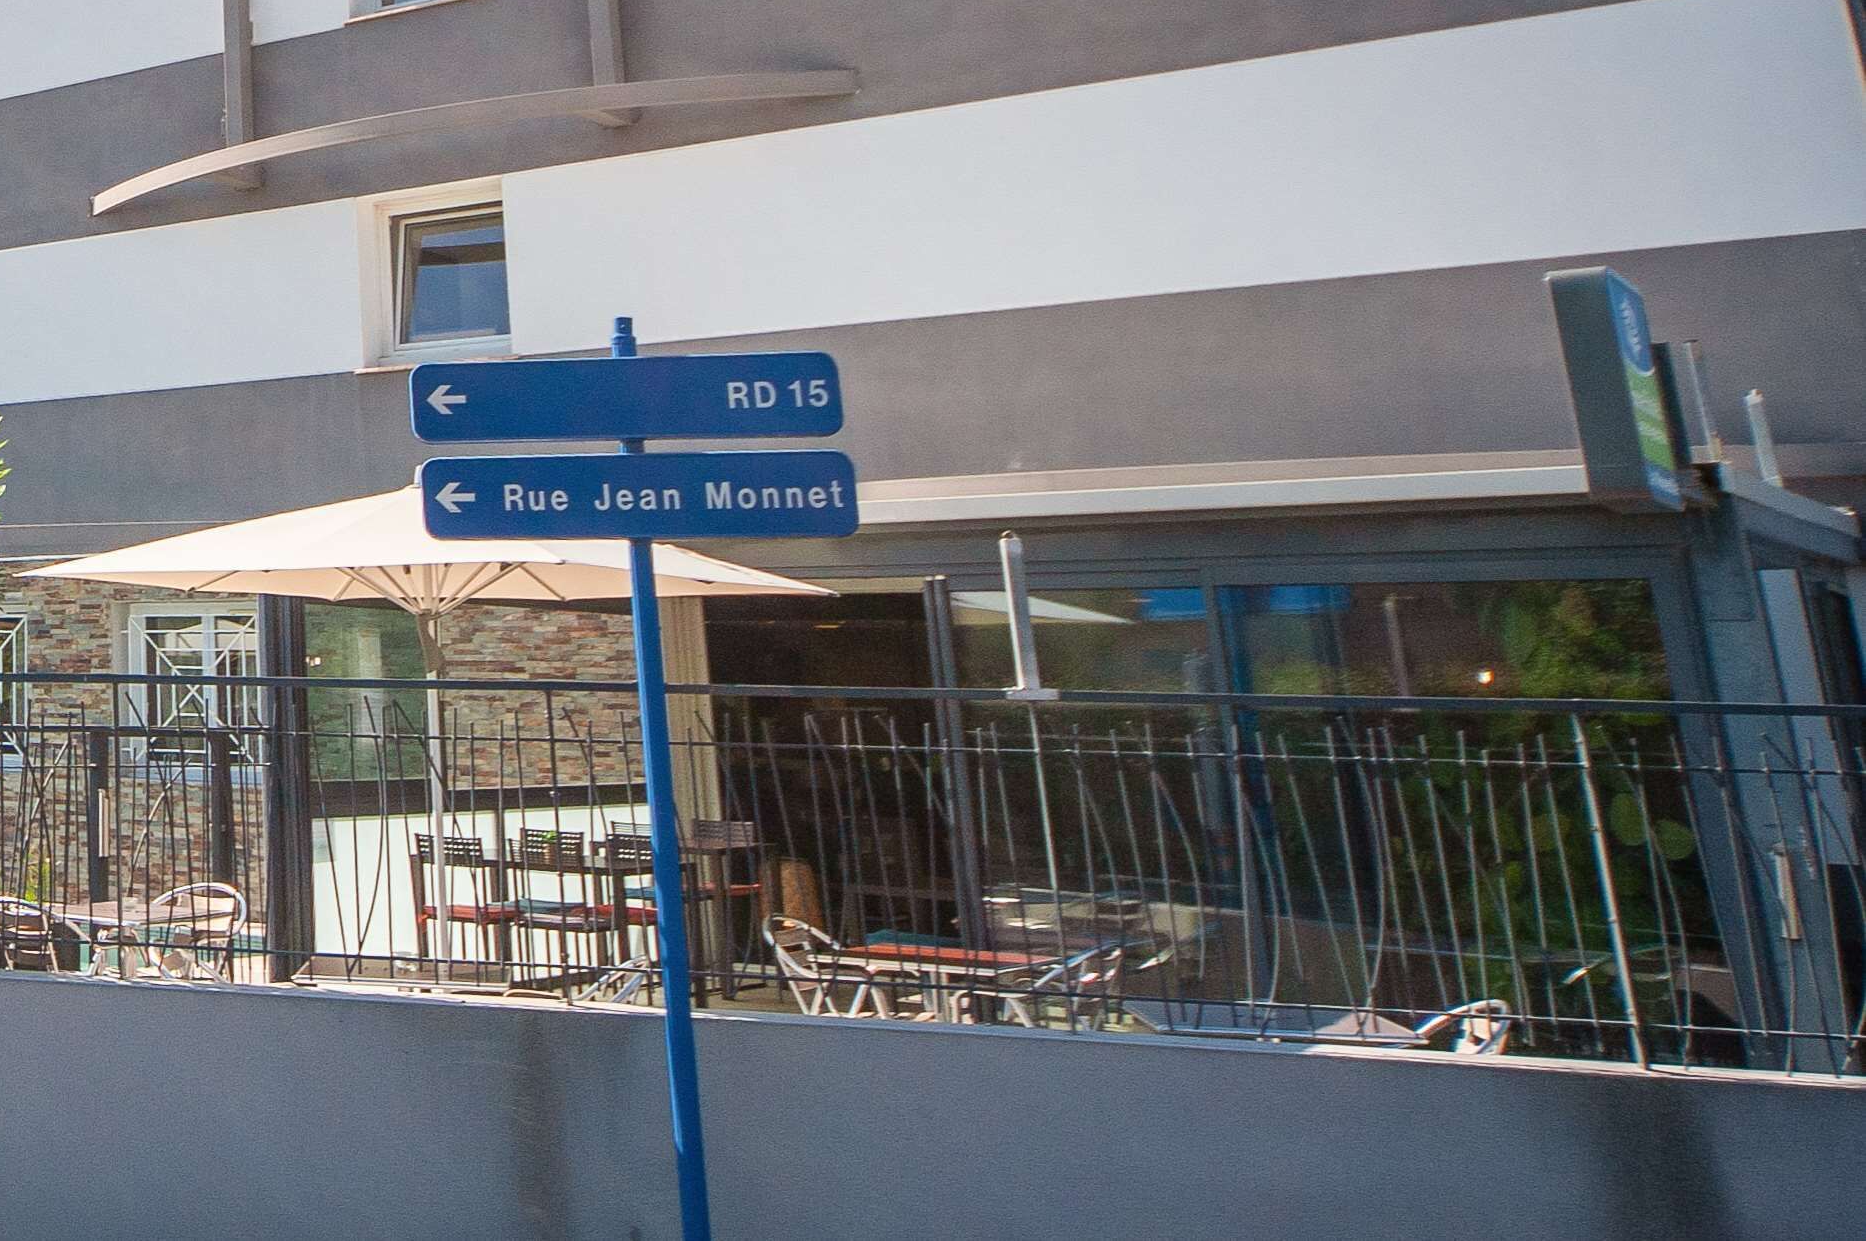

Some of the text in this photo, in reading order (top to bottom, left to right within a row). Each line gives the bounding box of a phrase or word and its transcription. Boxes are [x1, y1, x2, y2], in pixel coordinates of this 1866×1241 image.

[726, 379, 829, 409] RD 15
[503, 480, 844, 511] Rue Jean Monnet
